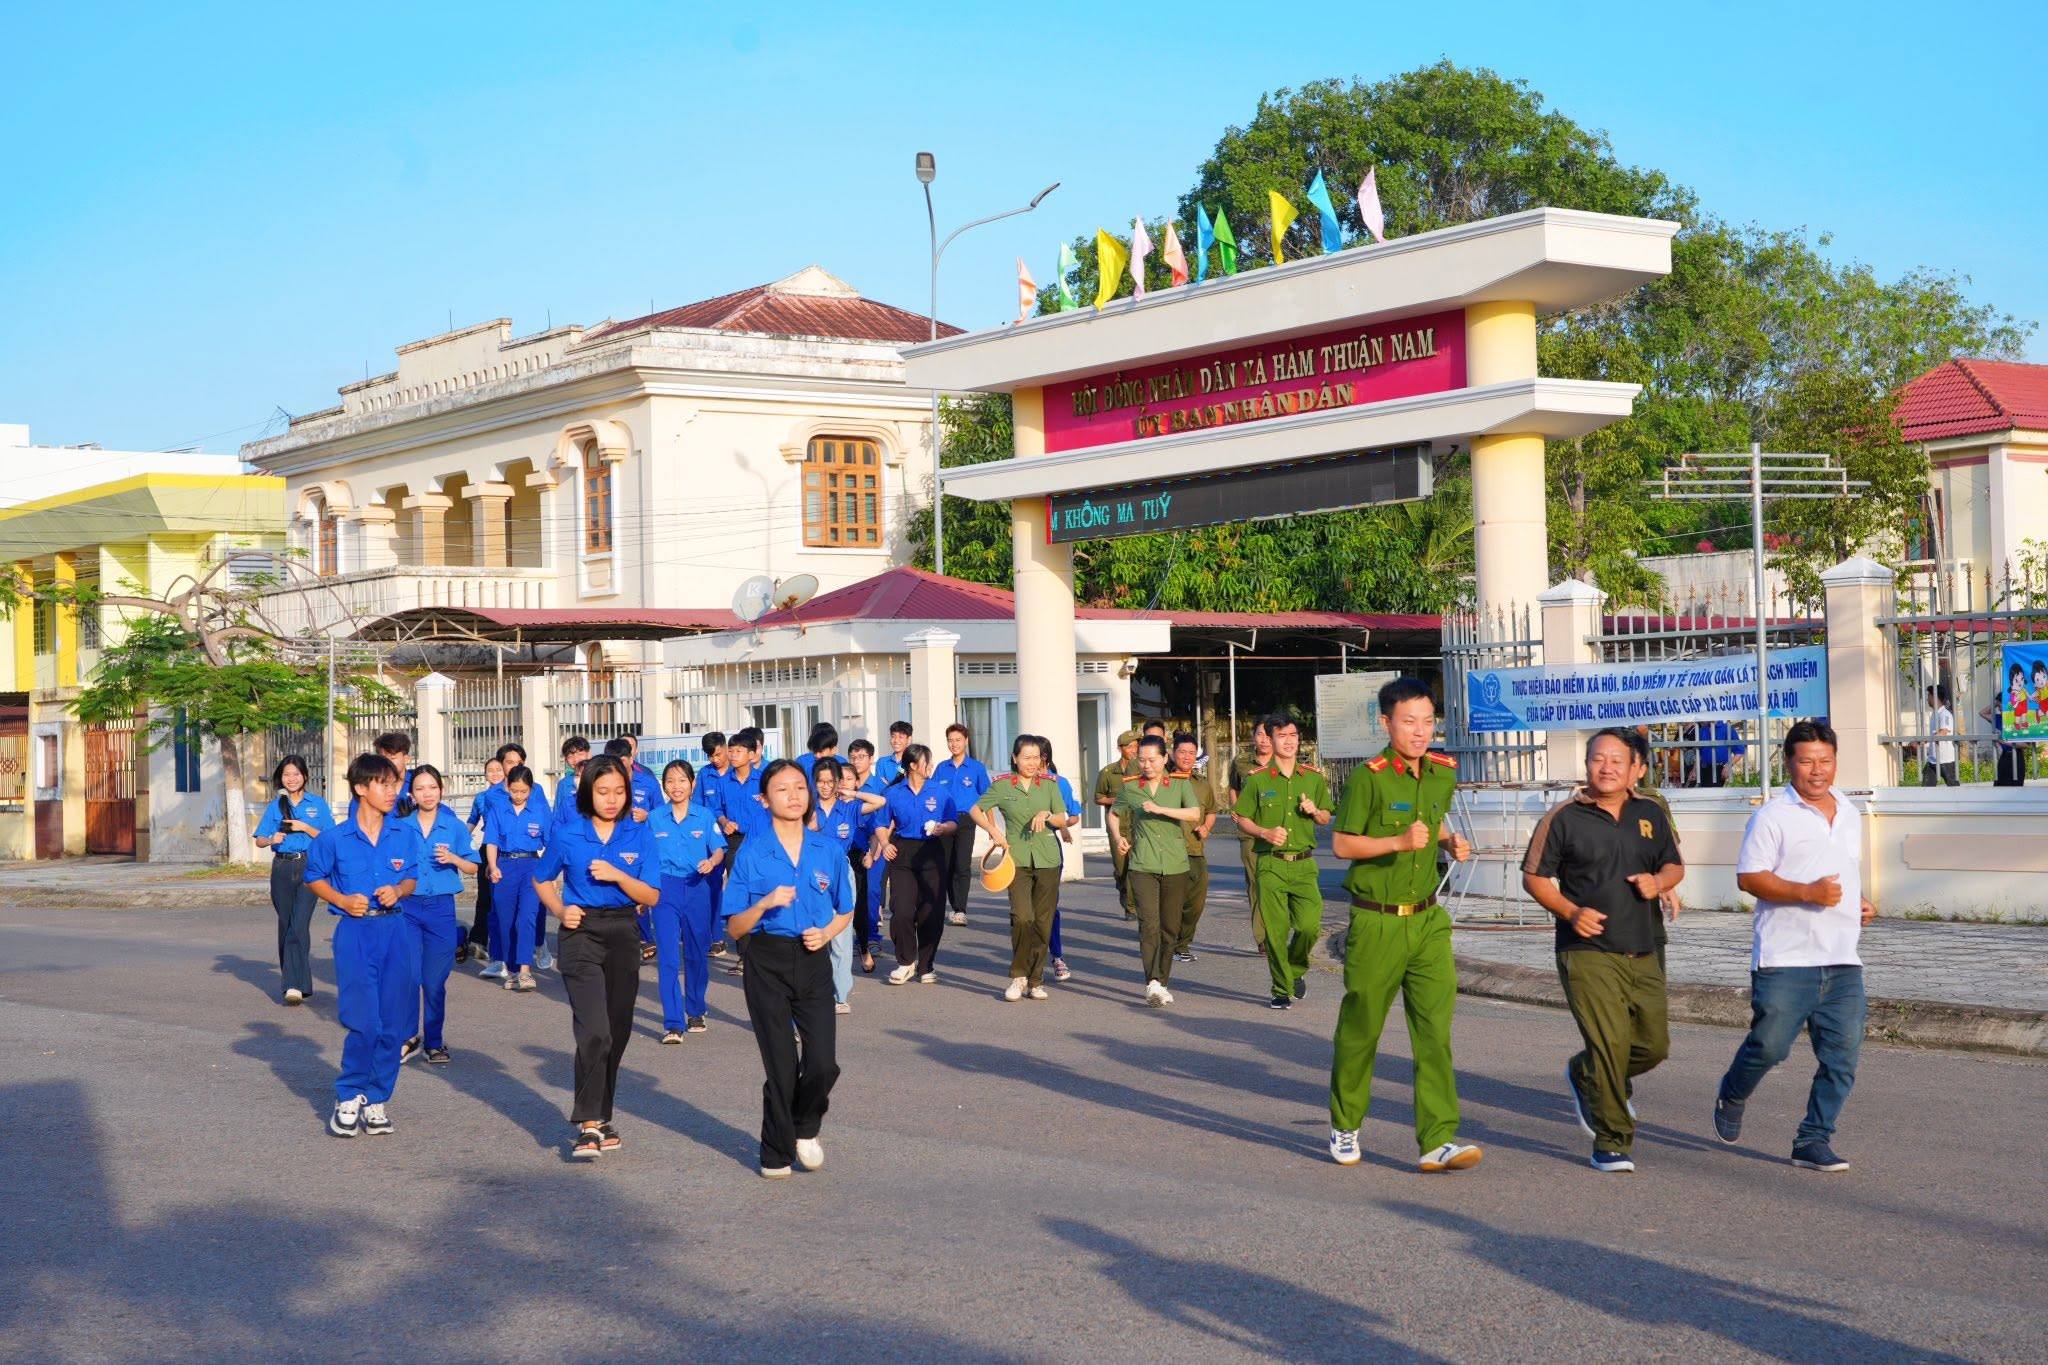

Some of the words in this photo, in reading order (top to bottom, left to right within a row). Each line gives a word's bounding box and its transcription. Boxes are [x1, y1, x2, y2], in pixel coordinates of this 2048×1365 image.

[1072, 384, 1099, 420] HỘI
[1104, 371, 1146, 411] ĐỒNG
[1148, 367, 1195, 402] NHÂN
[1200, 360, 1236, 394] DÂN
[1243, 352, 1267, 386] XÃ
[1272, 343, 1315, 381] HÀM
[1320, 334, 1384, 374] THUẬN
[1390, 328, 1437, 362] NAM
[1172, 404, 1225, 431] BAN
[1223, 390, 1299, 422] NHÂN
[1298, 380, 1356, 412] DÂN
[1065, 500, 1111, 529] KHÔNG
[1117, 502, 1135, 523] MA
[1545, 674, 1561, 695] BẢO
[1563, 671, 1585, 694] HIỂM
[1587, 674, 1599, 693] XÃ
[1622, 671, 1641, 692] BẢO
[1642, 669, 1667, 690] HIỂM
[1667, 673, 1675, 689] Y
[1785, 658, 1818, 682] NHIỆM
[1597, 700, 1627, 720] CHÍNH
[1628, 696, 1660, 719] QUYỀN
[1660, 697, 1681, 715] CÁC
[1681, 692, 1702, 714] CẤP
[1720, 690, 1739, 711] CỦA
[1740, 689, 1760, 711] TOÀ
[1768, 689, 1780, 709] XÃ
[1782, 687, 1799, 712] HỘI
[1638, 818, 1654, 839] R
